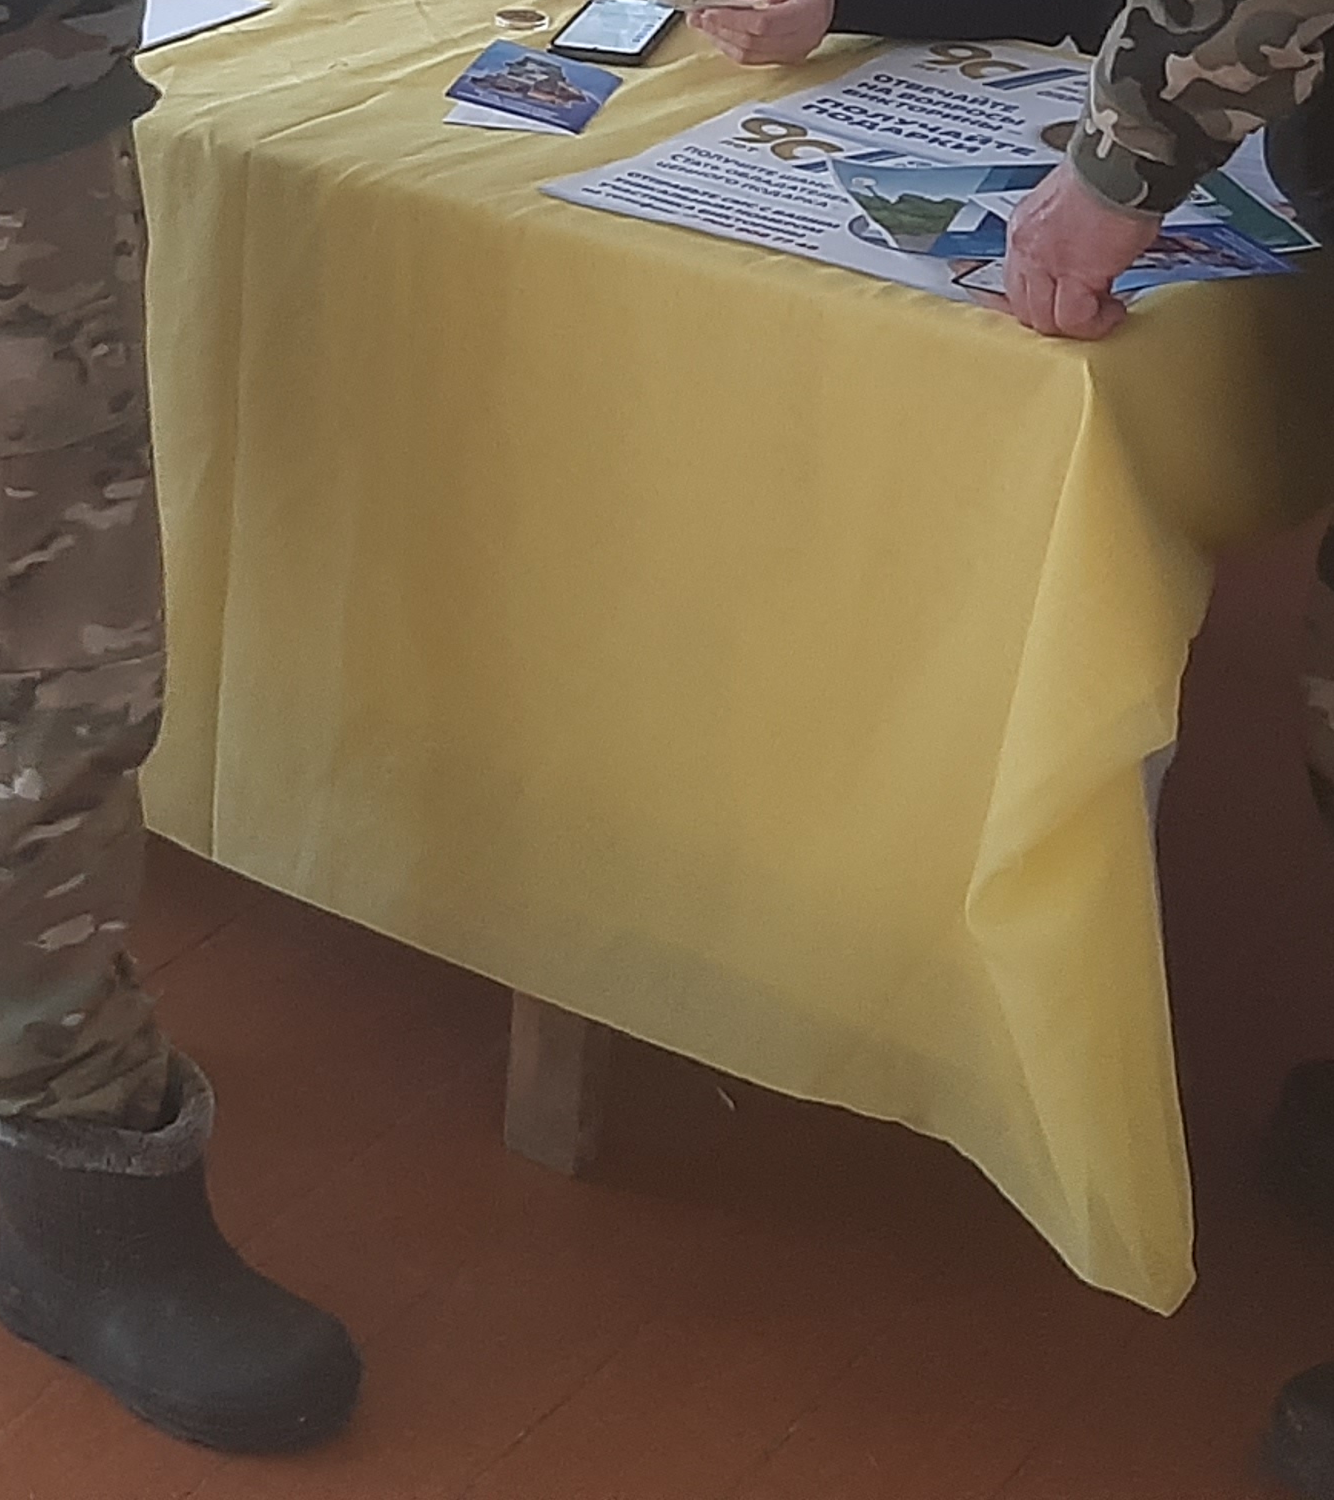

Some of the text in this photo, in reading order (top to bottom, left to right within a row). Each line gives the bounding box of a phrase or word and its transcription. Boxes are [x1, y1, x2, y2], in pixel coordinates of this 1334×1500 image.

[841, 88, 1003, 132] ВИКТОРИНЫ
[857, 81, 896, 96] НА
[896, 91, 1026, 127] ВОПРОСЫ
[873, 73, 1020, 114] ОТВЕЧАЙТЕ
[802, 104, 982, 155] ПОДАРКИ
[816, 97, 1037, 157] ПОЛУЧАЙТЕ
[683, 145, 779, 176] ПОЛУЧИТЕ
